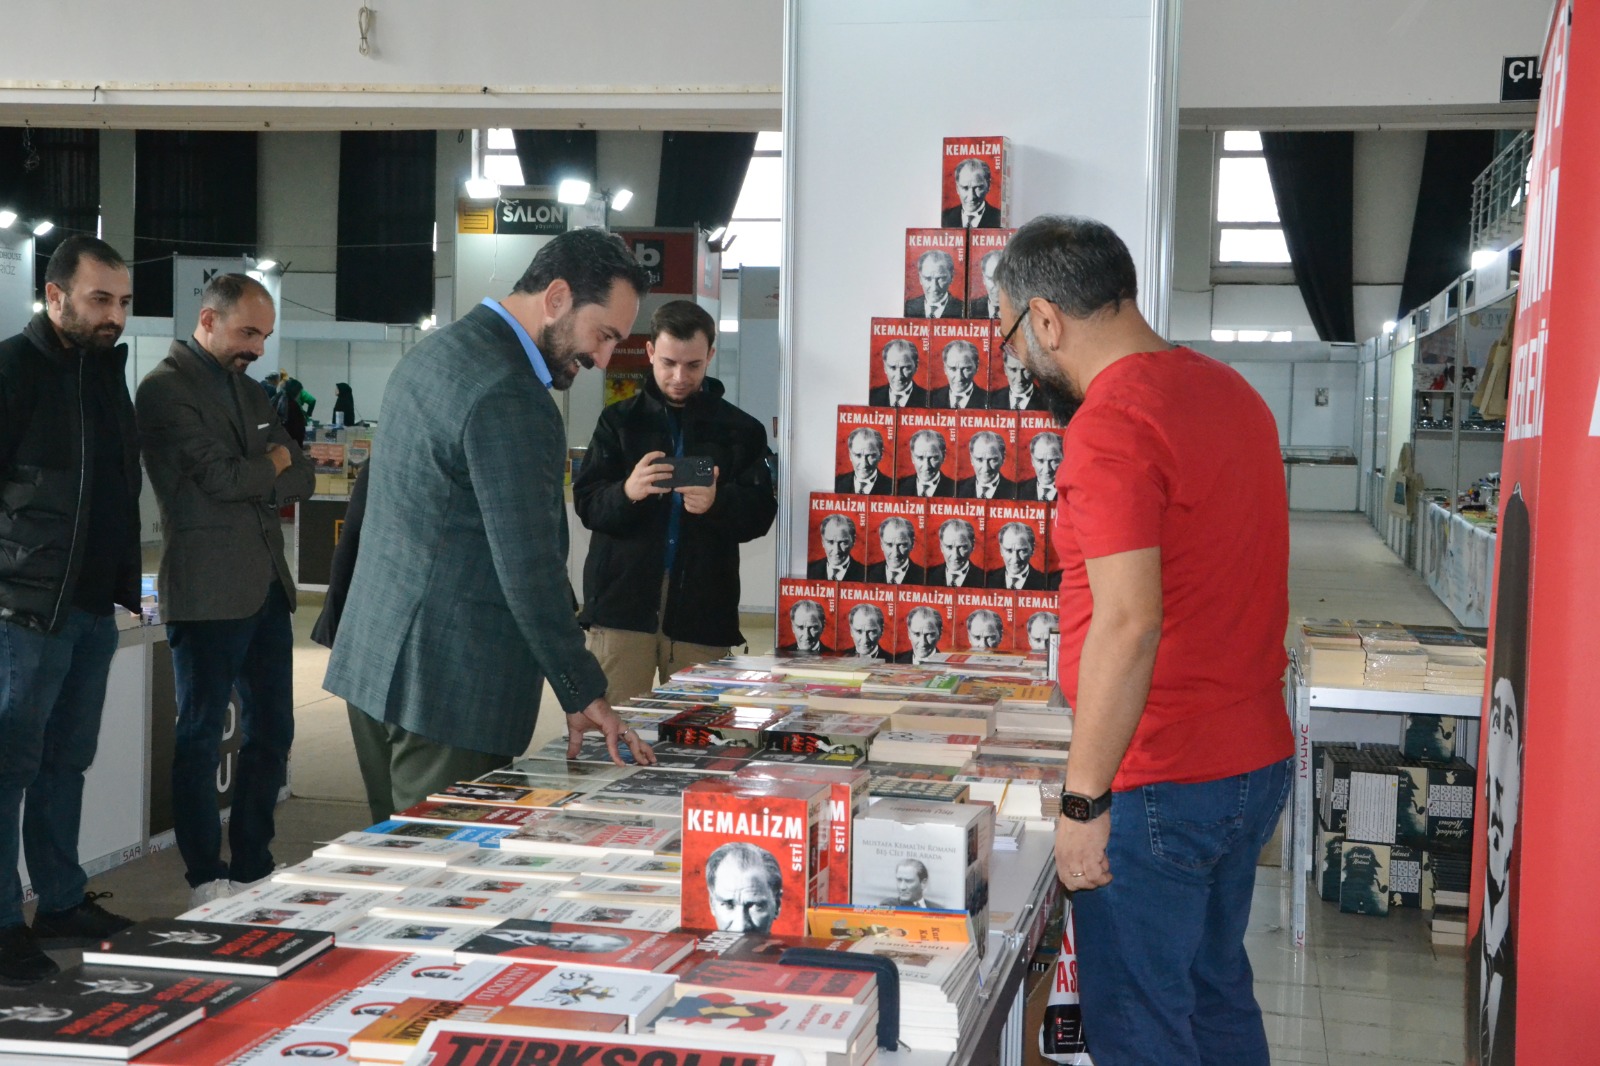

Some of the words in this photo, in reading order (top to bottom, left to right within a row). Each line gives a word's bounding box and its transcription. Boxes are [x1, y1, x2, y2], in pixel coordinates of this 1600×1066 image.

[1508, 60, 1542, 82] ÇI
[946, 141, 1000, 156] KEMALİZM
[502, 206, 564, 223] SALON
[909, 232, 964, 247] KEMALİZM
[874, 322, 928, 337] KEMALİZM
[934, 323, 988, 338] KEMALİZM
[840, 411, 894, 426] KEMALİZM
[901, 412, 956, 426] KEMALİZM
[960, 414, 1016, 428] KEMALİZM
[812, 498, 866, 512] KEMALİZM
[870, 500, 924, 515] KEMALİZM
[930, 502, 985, 517] KEMALİZM
[990, 505, 1045, 520] KEMALİZM
[782, 584, 835, 598] KEMALİZM
[840, 588, 894, 602] KEMALİZM
[898, 590, 952, 605] KEMALİZM
[958, 592, 1012, 608] KEMALİZM
[1018, 594, 1059, 609] KEMALİ
[687, 807, 803, 840] KEMALİZM
[833, 826, 845, 852] SETİ
[790, 844, 802, 872] SETİ
[1056, 961, 1080, 993] AS
